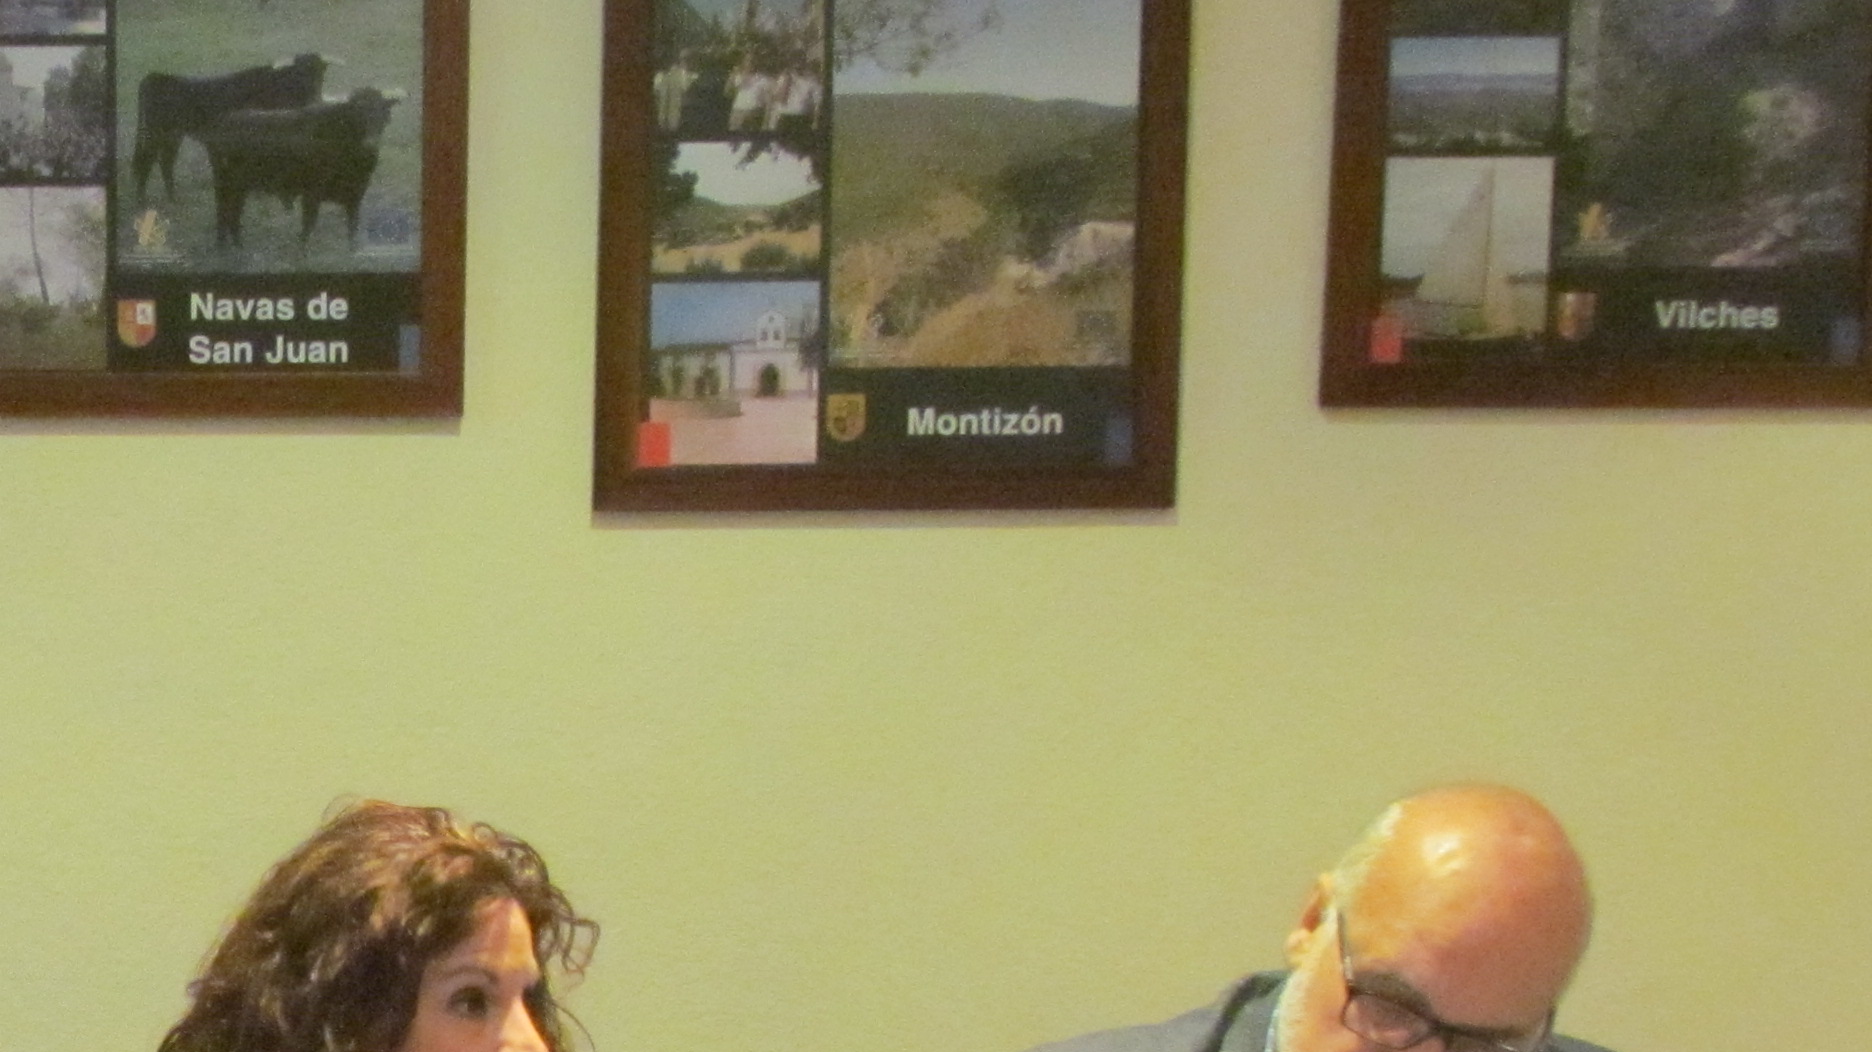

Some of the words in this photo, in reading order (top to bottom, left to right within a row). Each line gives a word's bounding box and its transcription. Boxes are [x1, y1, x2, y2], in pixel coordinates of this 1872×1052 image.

[191, 292, 295, 321] Navas
[307, 292, 349, 321] de
[1654, 300, 1781, 330] Vilches
[189, 334, 253, 364] San
[265, 334, 349, 364] Juan
[907, 404, 1063, 437] Montizón
